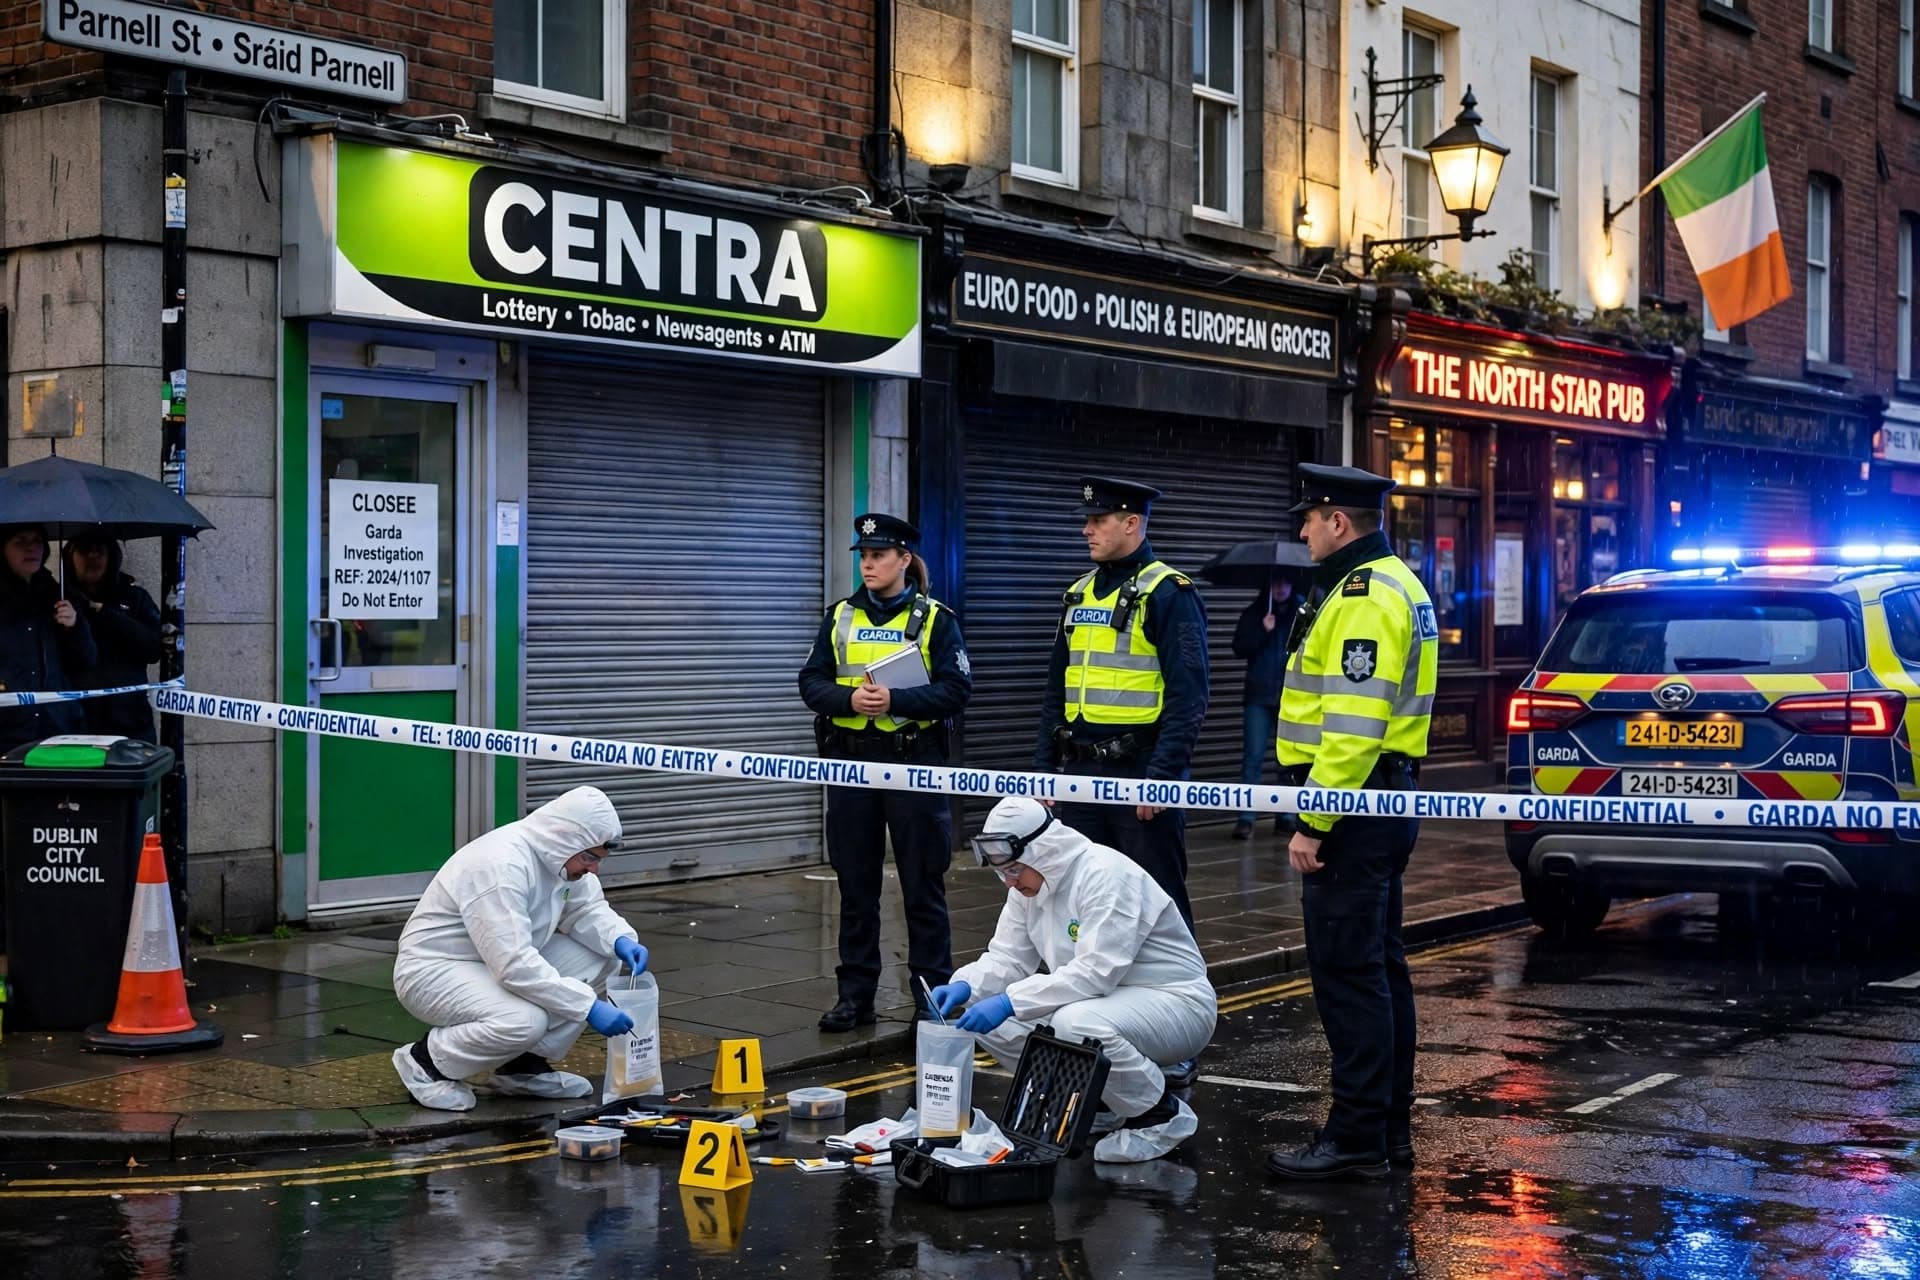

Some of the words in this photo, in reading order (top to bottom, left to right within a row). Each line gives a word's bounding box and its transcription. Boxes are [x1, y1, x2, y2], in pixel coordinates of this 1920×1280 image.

[59, 0, 160, 48] Parnell
[172, 19, 201, 56] St
[233, 31, 302, 74] Sráid
[311, 46, 395, 91] Parnell
[483, 181, 817, 313] CENTRA
[483, 293, 557, 329] Lottery
[578, 304, 636, 333] Tobac
[656, 314, 762, 348] Newsagents
[779, 331, 816, 354] ATM
[964, 271, 1019, 313] EURO
[1024, 282, 1078, 321] FOOD
[1095, 292, 1159, 335] POLISH
[1164, 305, 1176, 337] &
[1181, 307, 1267, 350] EUROPEAN
[1271, 322, 1331, 361] GROCER
[1411, 350, 1461, 399] THE
[1468, 360, 1545, 410] NORTH
[1550, 373, 1602, 418] STAR
[1607, 382, 1645, 424] PUB
[352, 493, 416, 514] CLOSEE
[365, 524, 402, 540] Garda
[344, 545, 424, 564] Investigation
[335, 568, 364, 584] REF:
[367, 569, 431, 586] 2024/1107
[342, 592, 359, 607] Do
[363, 592, 385, 608] Not
[1074, 610, 1107, 623] GARDA
[860, 630, 899, 641] GARDA
[156, 689, 194, 713] GARDA
[198, 696, 216, 716] NO
[219, 700, 262, 722] ENTRY
[278, 708, 379, 738] CONFIDENTIAL
[412, 724, 441, 745] TEL:
[447, 728, 481, 749] 1800
[485, 732, 537, 755] 666111
[571, 740, 627, 765] GARDA
[632, 746, 656, 767] NO
[661, 749, 718, 772] ENTRY
[740, 755, 870, 785] CONFIDENTIAL
[907, 768, 942, 790] TEL:
[949, 772, 989, 793] 1800
[995, 775, 1055, 797] 666111
[1092, 780, 1130, 801] TEL:
[1136, 783, 1180, 805] 1800
[1186, 785, 1253, 808] 666111
[1296, 790, 1370, 813] GARDA
[1376, 793, 1406, 815] NO
[1414, 795, 1486, 818] ENTRY
[1519, 798, 1694, 824] CONFIDENTIAL
[1747, 803, 1834, 827] GARDA
[1846, 806, 1883, 828] NO
[1537, 747, 1580, 761] GARDA
[1783, 752, 1837, 767] GARDA
[33, 828, 98, 844] DUBLIN
[46, 847, 85, 864] CITY
[26, 867, 104, 883] COUNCIL
[734, 1046, 748, 1084] 1
[694, 1132, 719, 1176] 2
